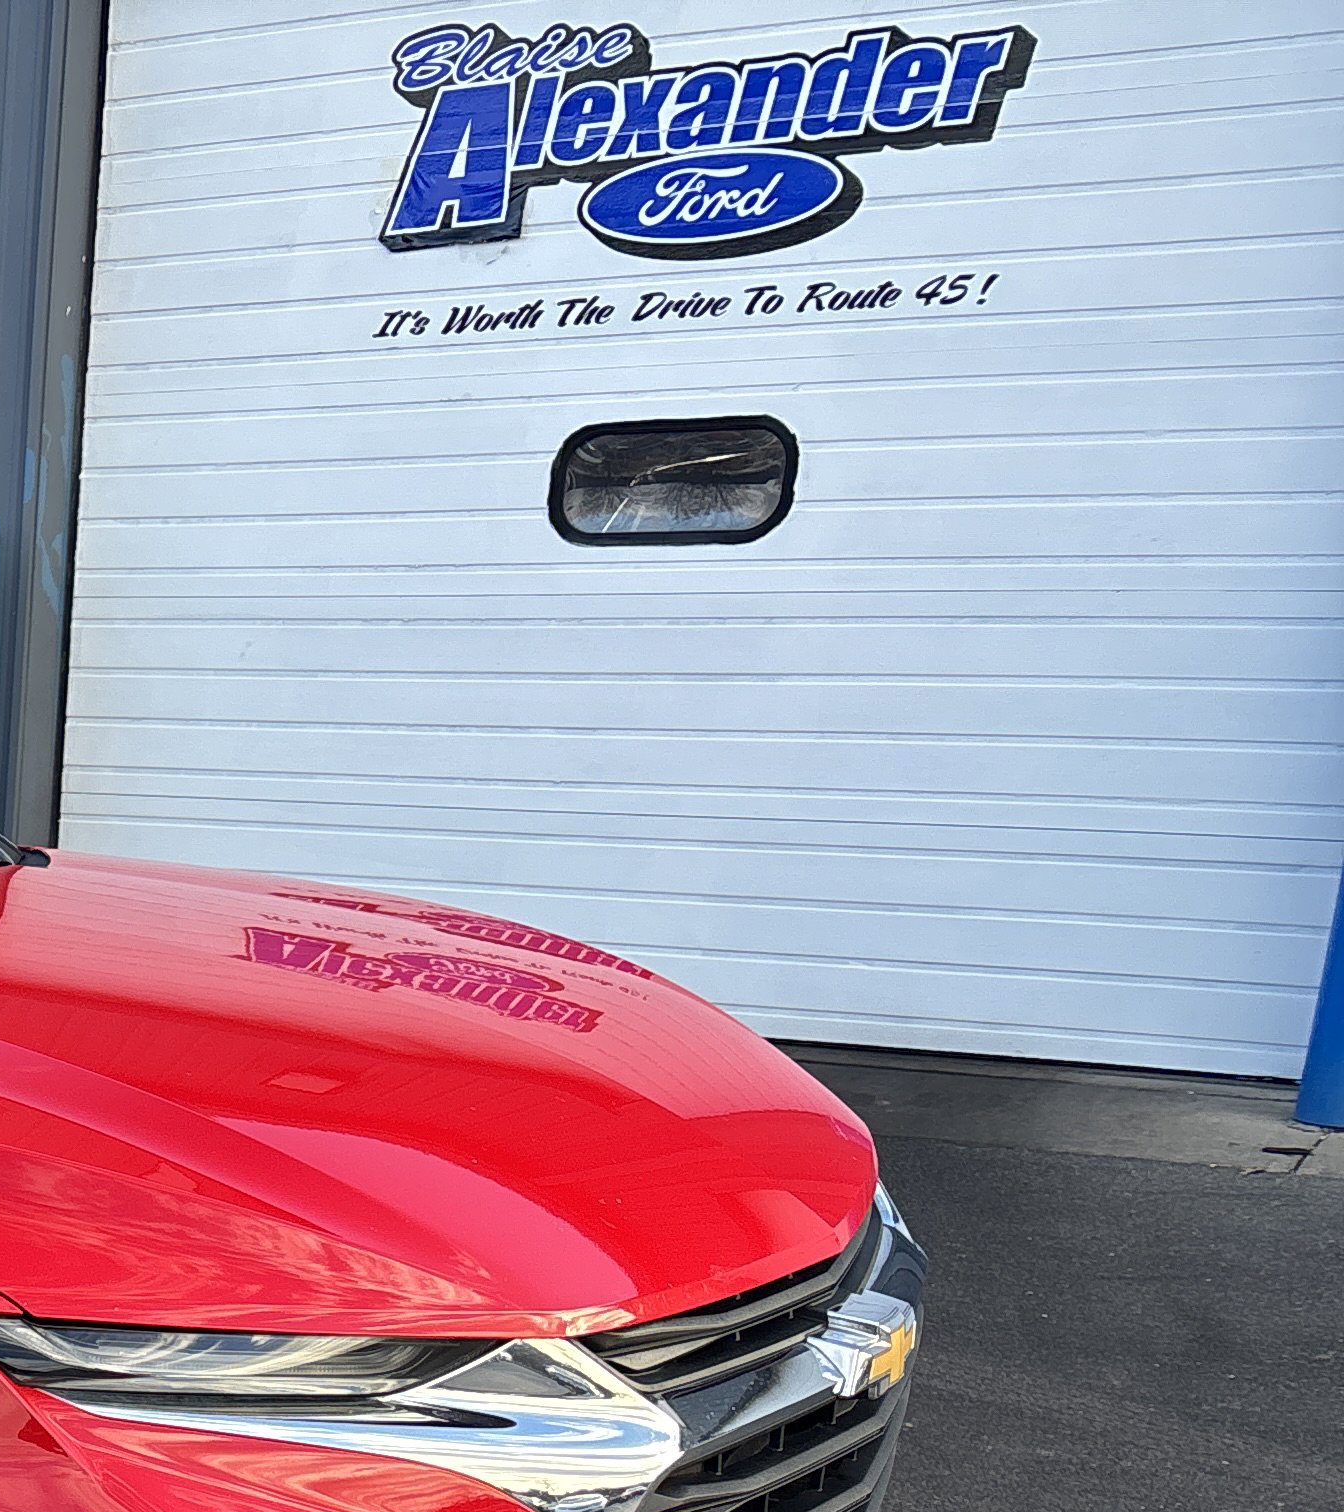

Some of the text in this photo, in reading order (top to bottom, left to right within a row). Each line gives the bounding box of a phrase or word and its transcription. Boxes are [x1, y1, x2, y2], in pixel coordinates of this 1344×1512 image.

[395, 28, 635, 92] Blaise
[382, 29, 1016, 238] Alexander
[638, 165, 780, 226] Ford
[372, 273, 1000, 339] It's Worth The Drive To Route 45!
